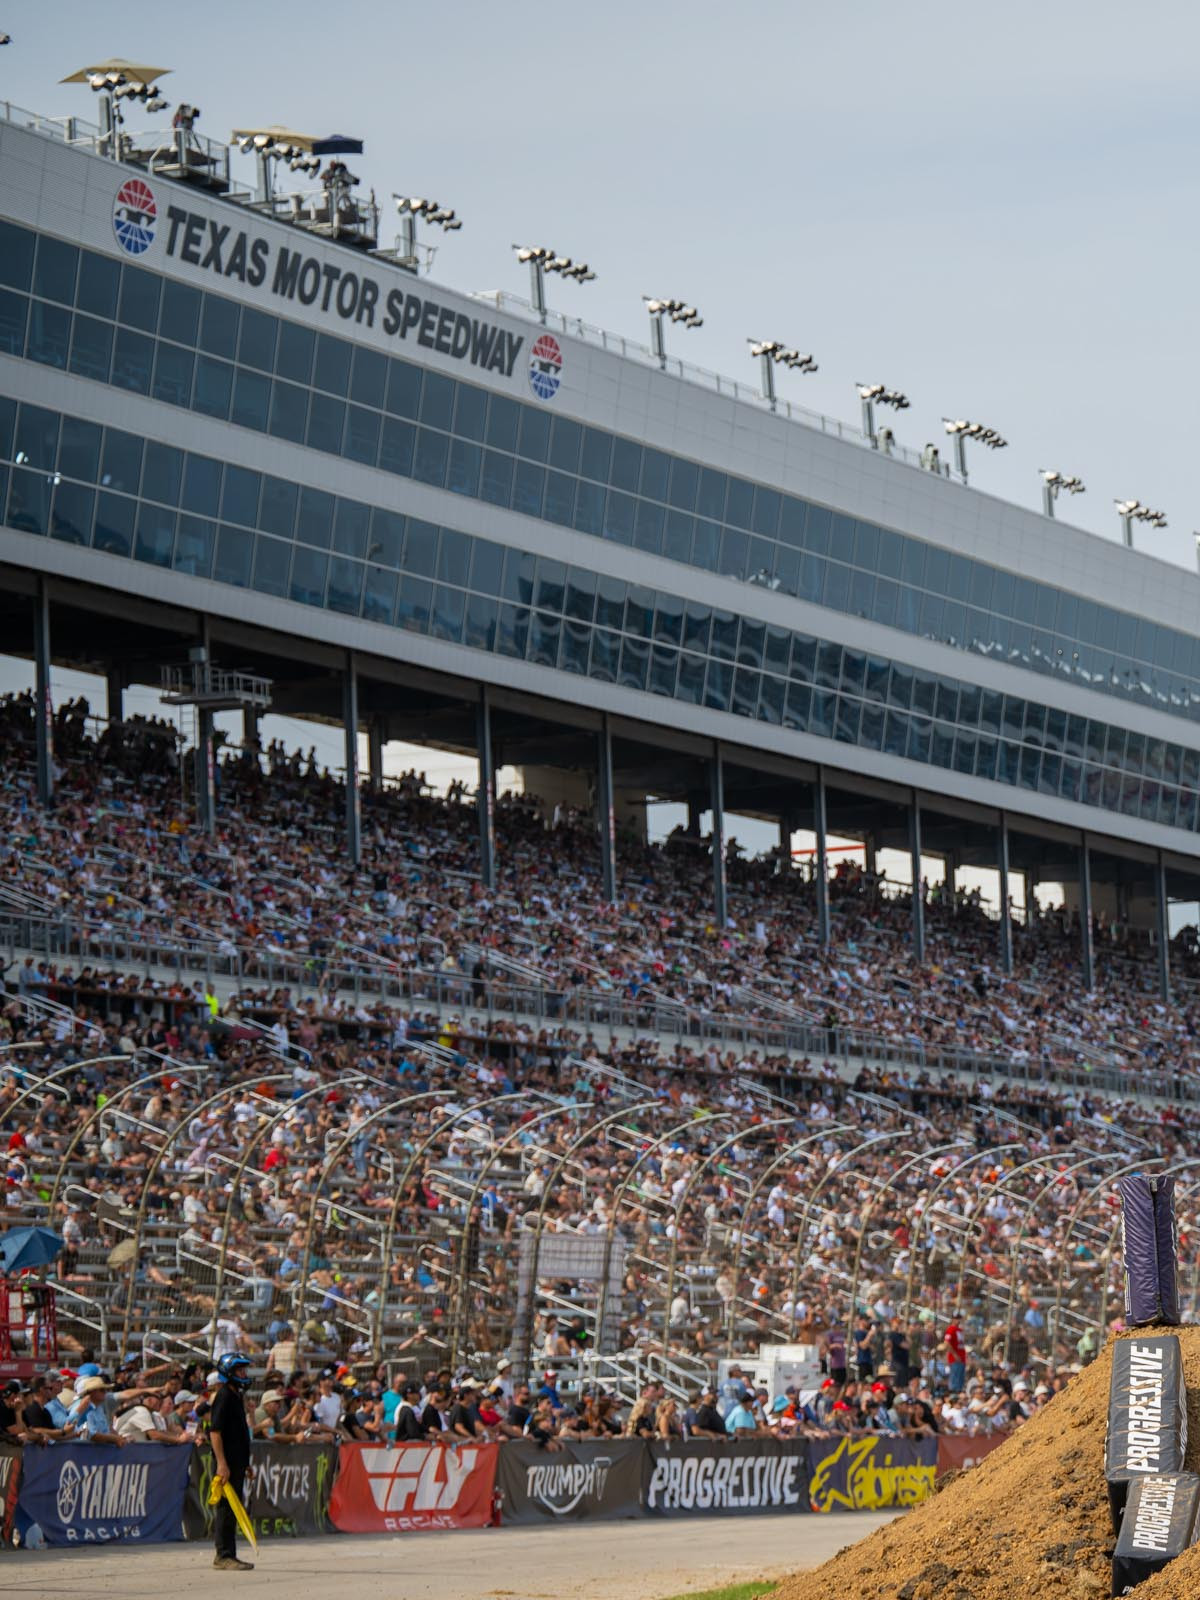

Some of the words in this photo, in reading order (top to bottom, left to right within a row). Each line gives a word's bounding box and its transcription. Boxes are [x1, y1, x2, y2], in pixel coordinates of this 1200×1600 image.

[166, 205, 269, 287] TEXAS
[272, 246, 379, 328] MOTOR
[383, 288, 525, 377] SPEEDWAY
[1126, 1345, 1163, 1473] PROGRESSIVE
[81, 1463, 149, 1519] YAMAHA
[360, 1447, 478, 1512] FLY
[526, 1463, 597, 1514] TRIUMPH
[648, 1455, 801, 1508] PROGRESSIVE
[66, 1525, 141, 1541] RACING
[1132, 1476, 1177, 1552] PROGRESSIVE
